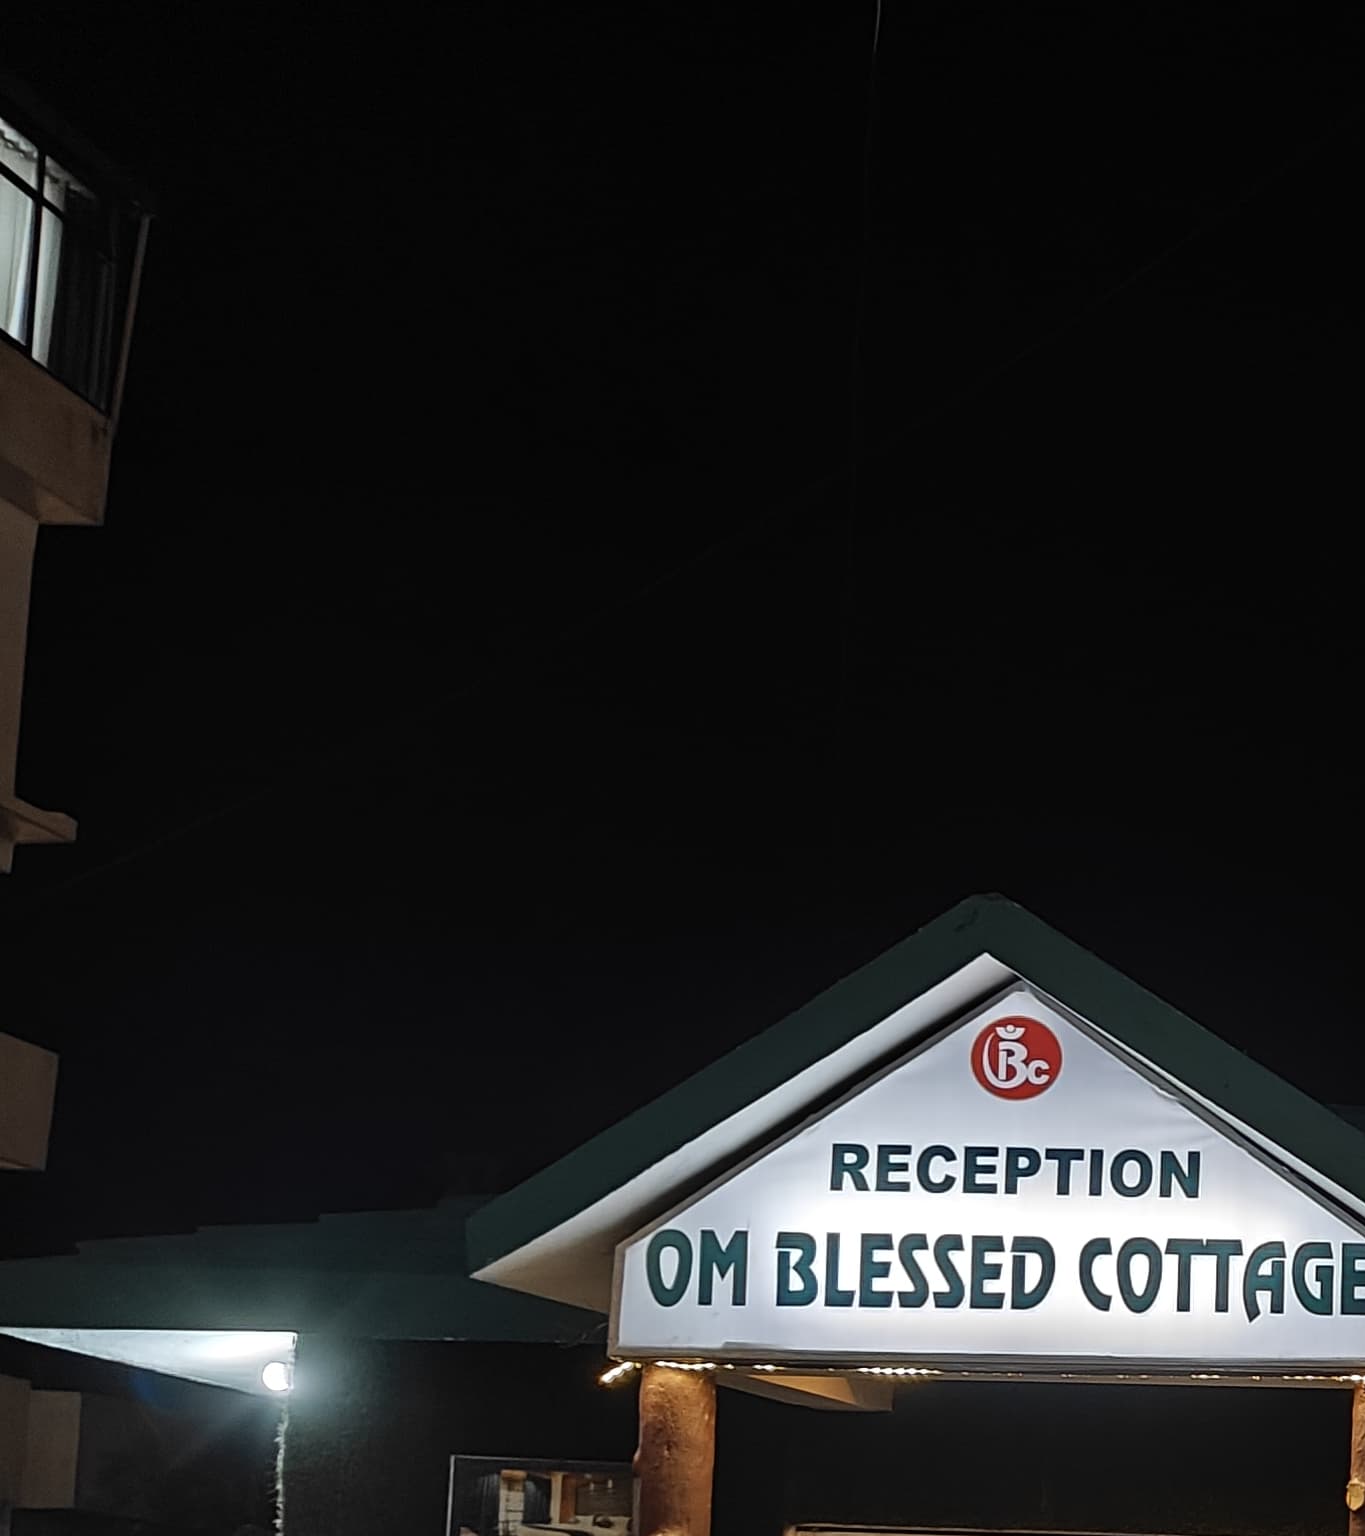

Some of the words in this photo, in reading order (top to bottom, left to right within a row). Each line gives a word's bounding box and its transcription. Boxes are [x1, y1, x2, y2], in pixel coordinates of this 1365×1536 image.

[830, 1143, 1202, 1199] RECEPTION
[646, 1229, 749, 1308] OM
[775, 1231, 1056, 1311] BLESSED
